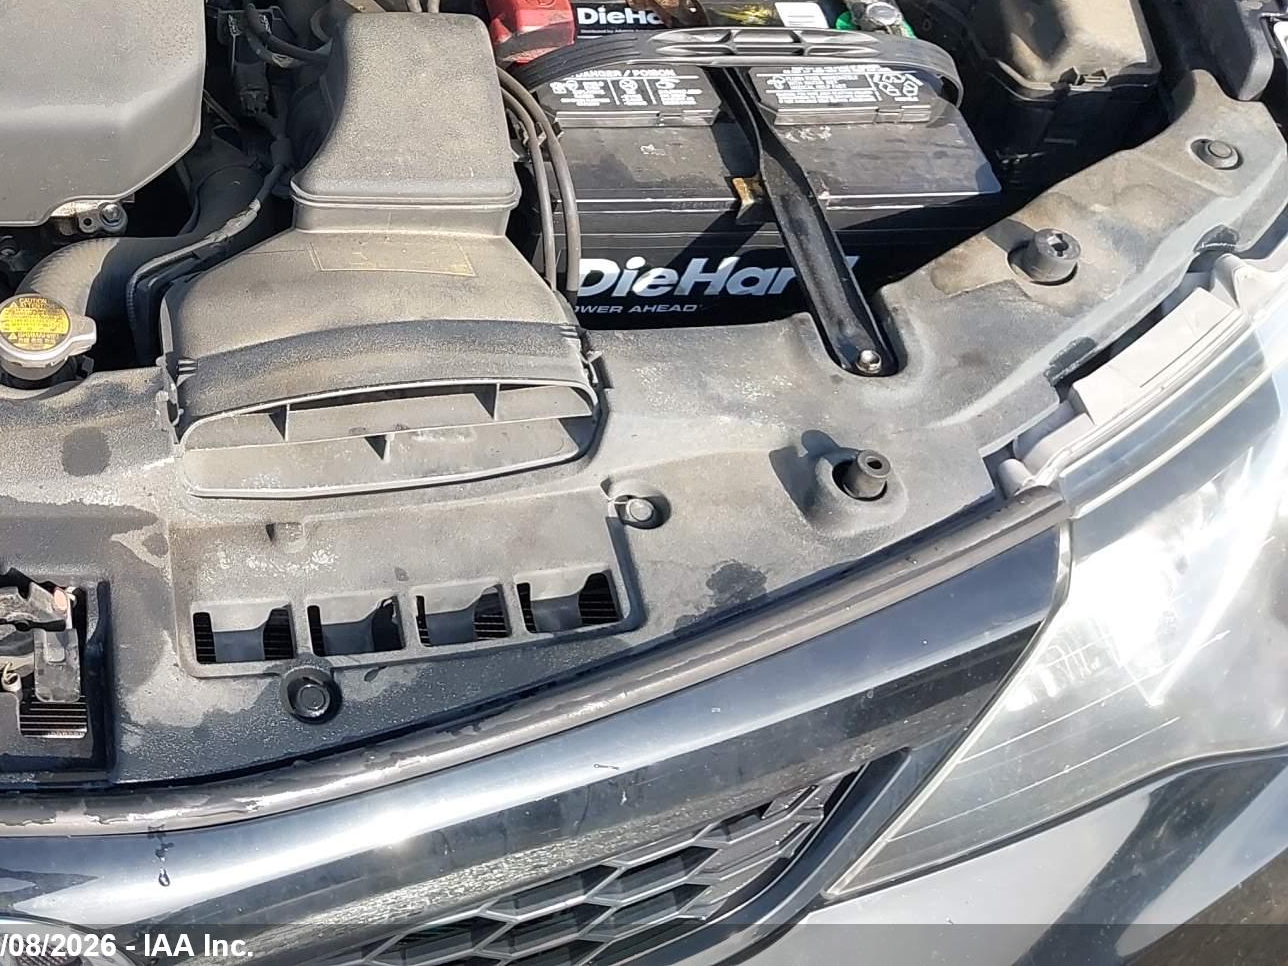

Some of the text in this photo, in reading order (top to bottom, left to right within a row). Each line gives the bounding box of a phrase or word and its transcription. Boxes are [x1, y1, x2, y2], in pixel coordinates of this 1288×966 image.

[576, 5, 665, 25] DieHa
[577, 256, 859, 297] DieHar
[574, 304, 698, 314] WER AHEAD
